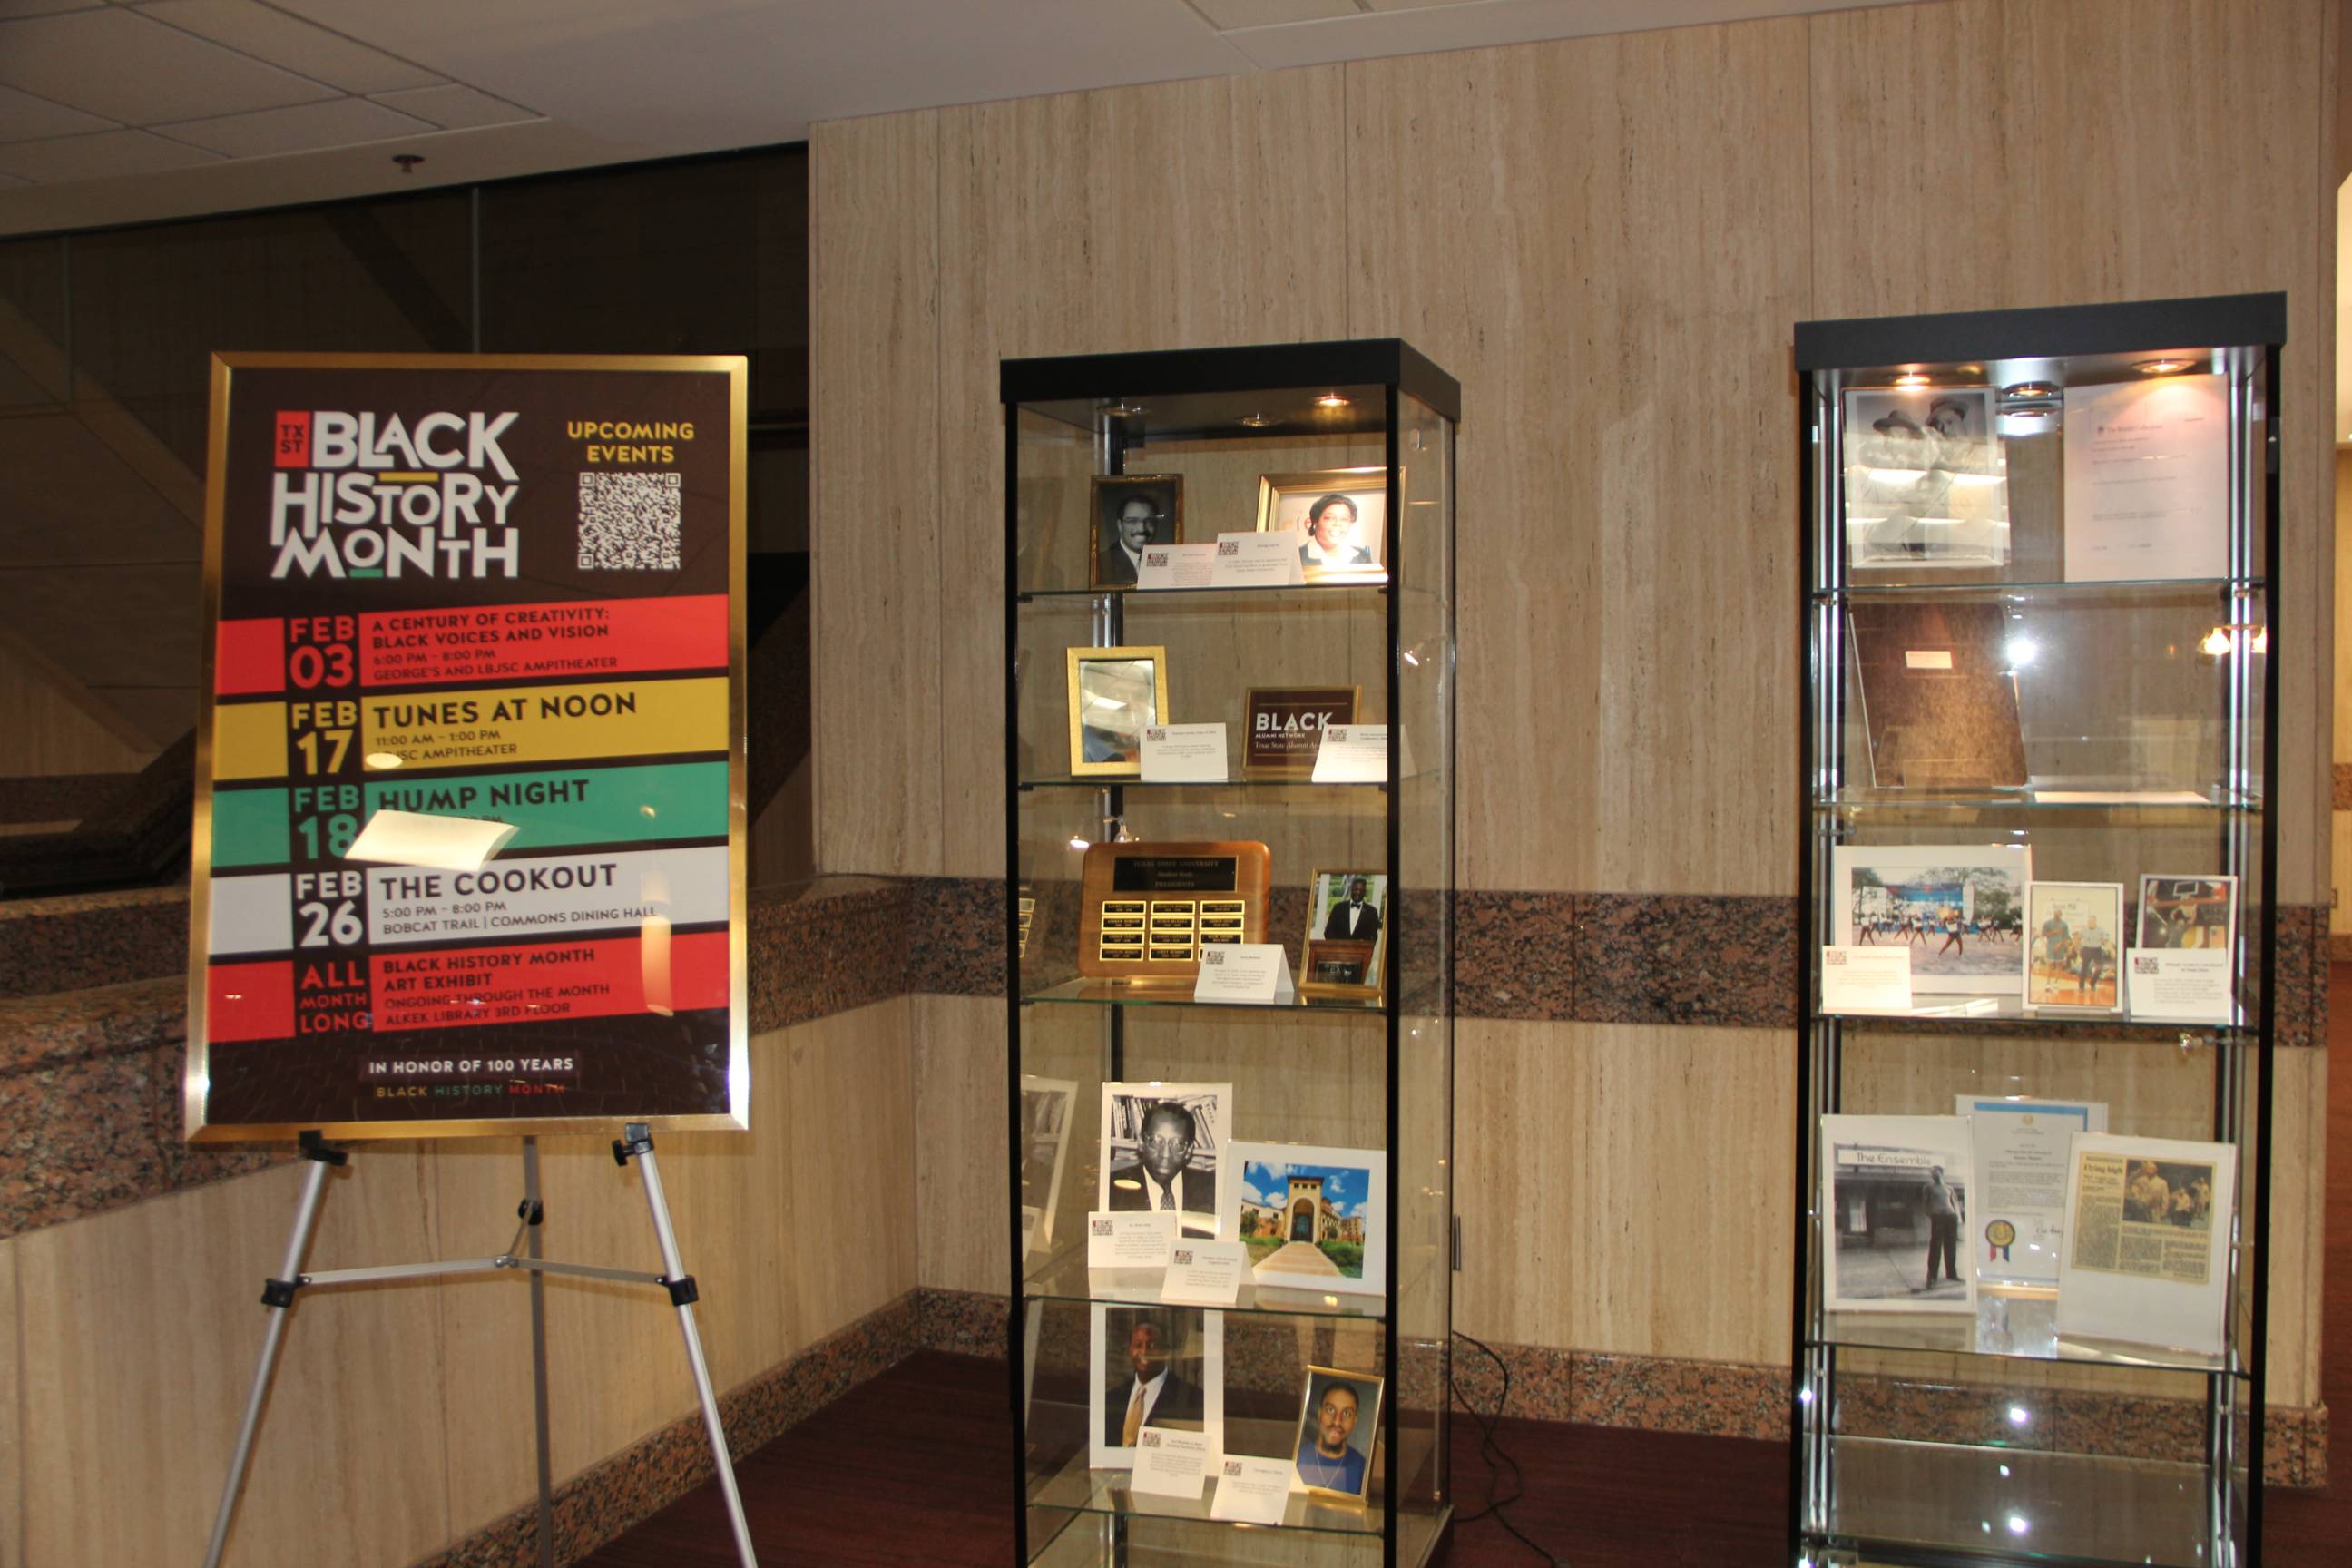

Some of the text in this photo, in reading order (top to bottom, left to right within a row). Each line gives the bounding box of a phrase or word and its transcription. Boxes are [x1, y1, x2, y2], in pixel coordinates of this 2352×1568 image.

[280, 425, 304, 438] TX
[567, 421, 695, 440] UPCOMING
[279, 440, 304, 454] ST
[311, 410, 520, 482] BLACK
[586, 445, 674, 463] EVENTS
[270, 471, 520, 546] HISTORY
[270, 526, 520, 580] MONTH
[289, 616, 355, 643] FEB
[373, 608, 610, 632] A CENTURY OF CREATIVITY:
[373, 624, 609, 650] BLACK VOICES AND VISION
[289, 643, 355, 689] 03
[373, 657, 617, 681] GEORGE'S AND LBJSC AMPITHEATER
[374, 652, 402, 665] 6:00
[407, 651, 427, 663] PM
[442, 649, 471, 662] 8:00
[475, 647, 496, 660] PM
[291, 701, 358, 729] FEB
[373, 692, 636, 729] TUNES AT NOON
[1256, 711, 1333, 731] BLACK
[375, 734, 407, 747] 11:00
[411, 731, 434, 744] AM
[449, 730, 475, 742] 1:00
[479, 728, 501, 740] PM
[296, 729, 353, 776] 17
[422, 742, 517, 760] AMPITHEATER
[294, 785, 359, 813] FEB
[379, 779, 589, 812] HUMP NIGHT
[298, 813, 358, 859] 18
[296, 871, 363, 899] FEB
[379, 864, 617, 901] THE COOKOUT
[382, 906, 410, 919] 5:00
[415, 904, 436, 917] PM
[452, 901, 481, 915] 8:00
[485, 899, 506, 913] PM
[383, 919, 437, 936] BOBCAT
[442, 916, 479, 931] TRAIL
[490, 911, 567, 927] COMMONS
[571, 907, 620, 924] DINING
[623, 905, 656, 919] HALL
[299, 899, 362, 946] 26
[383, 948, 594, 974] BLACK HISTORY MONTH
[299, 961, 363, 990] ALL
[384, 973, 493, 993] ART EXHIBIT
[299, 991, 367, 1010] MONTH
[385, 984, 610, 1011] ONGOING THROUGH THE MONTH
[299, 1011, 369, 1034] LONG
[386, 1002, 571, 1026] ALKEK LIBRARY 3RD FLOOR
[369, 1057, 573, 1073] IN HONOR OF 100 YEARS
[377, 1083, 567, 1098] BLACK HISTORY MONTH
[1857, 1152, 1933, 1166] The Ensemble
